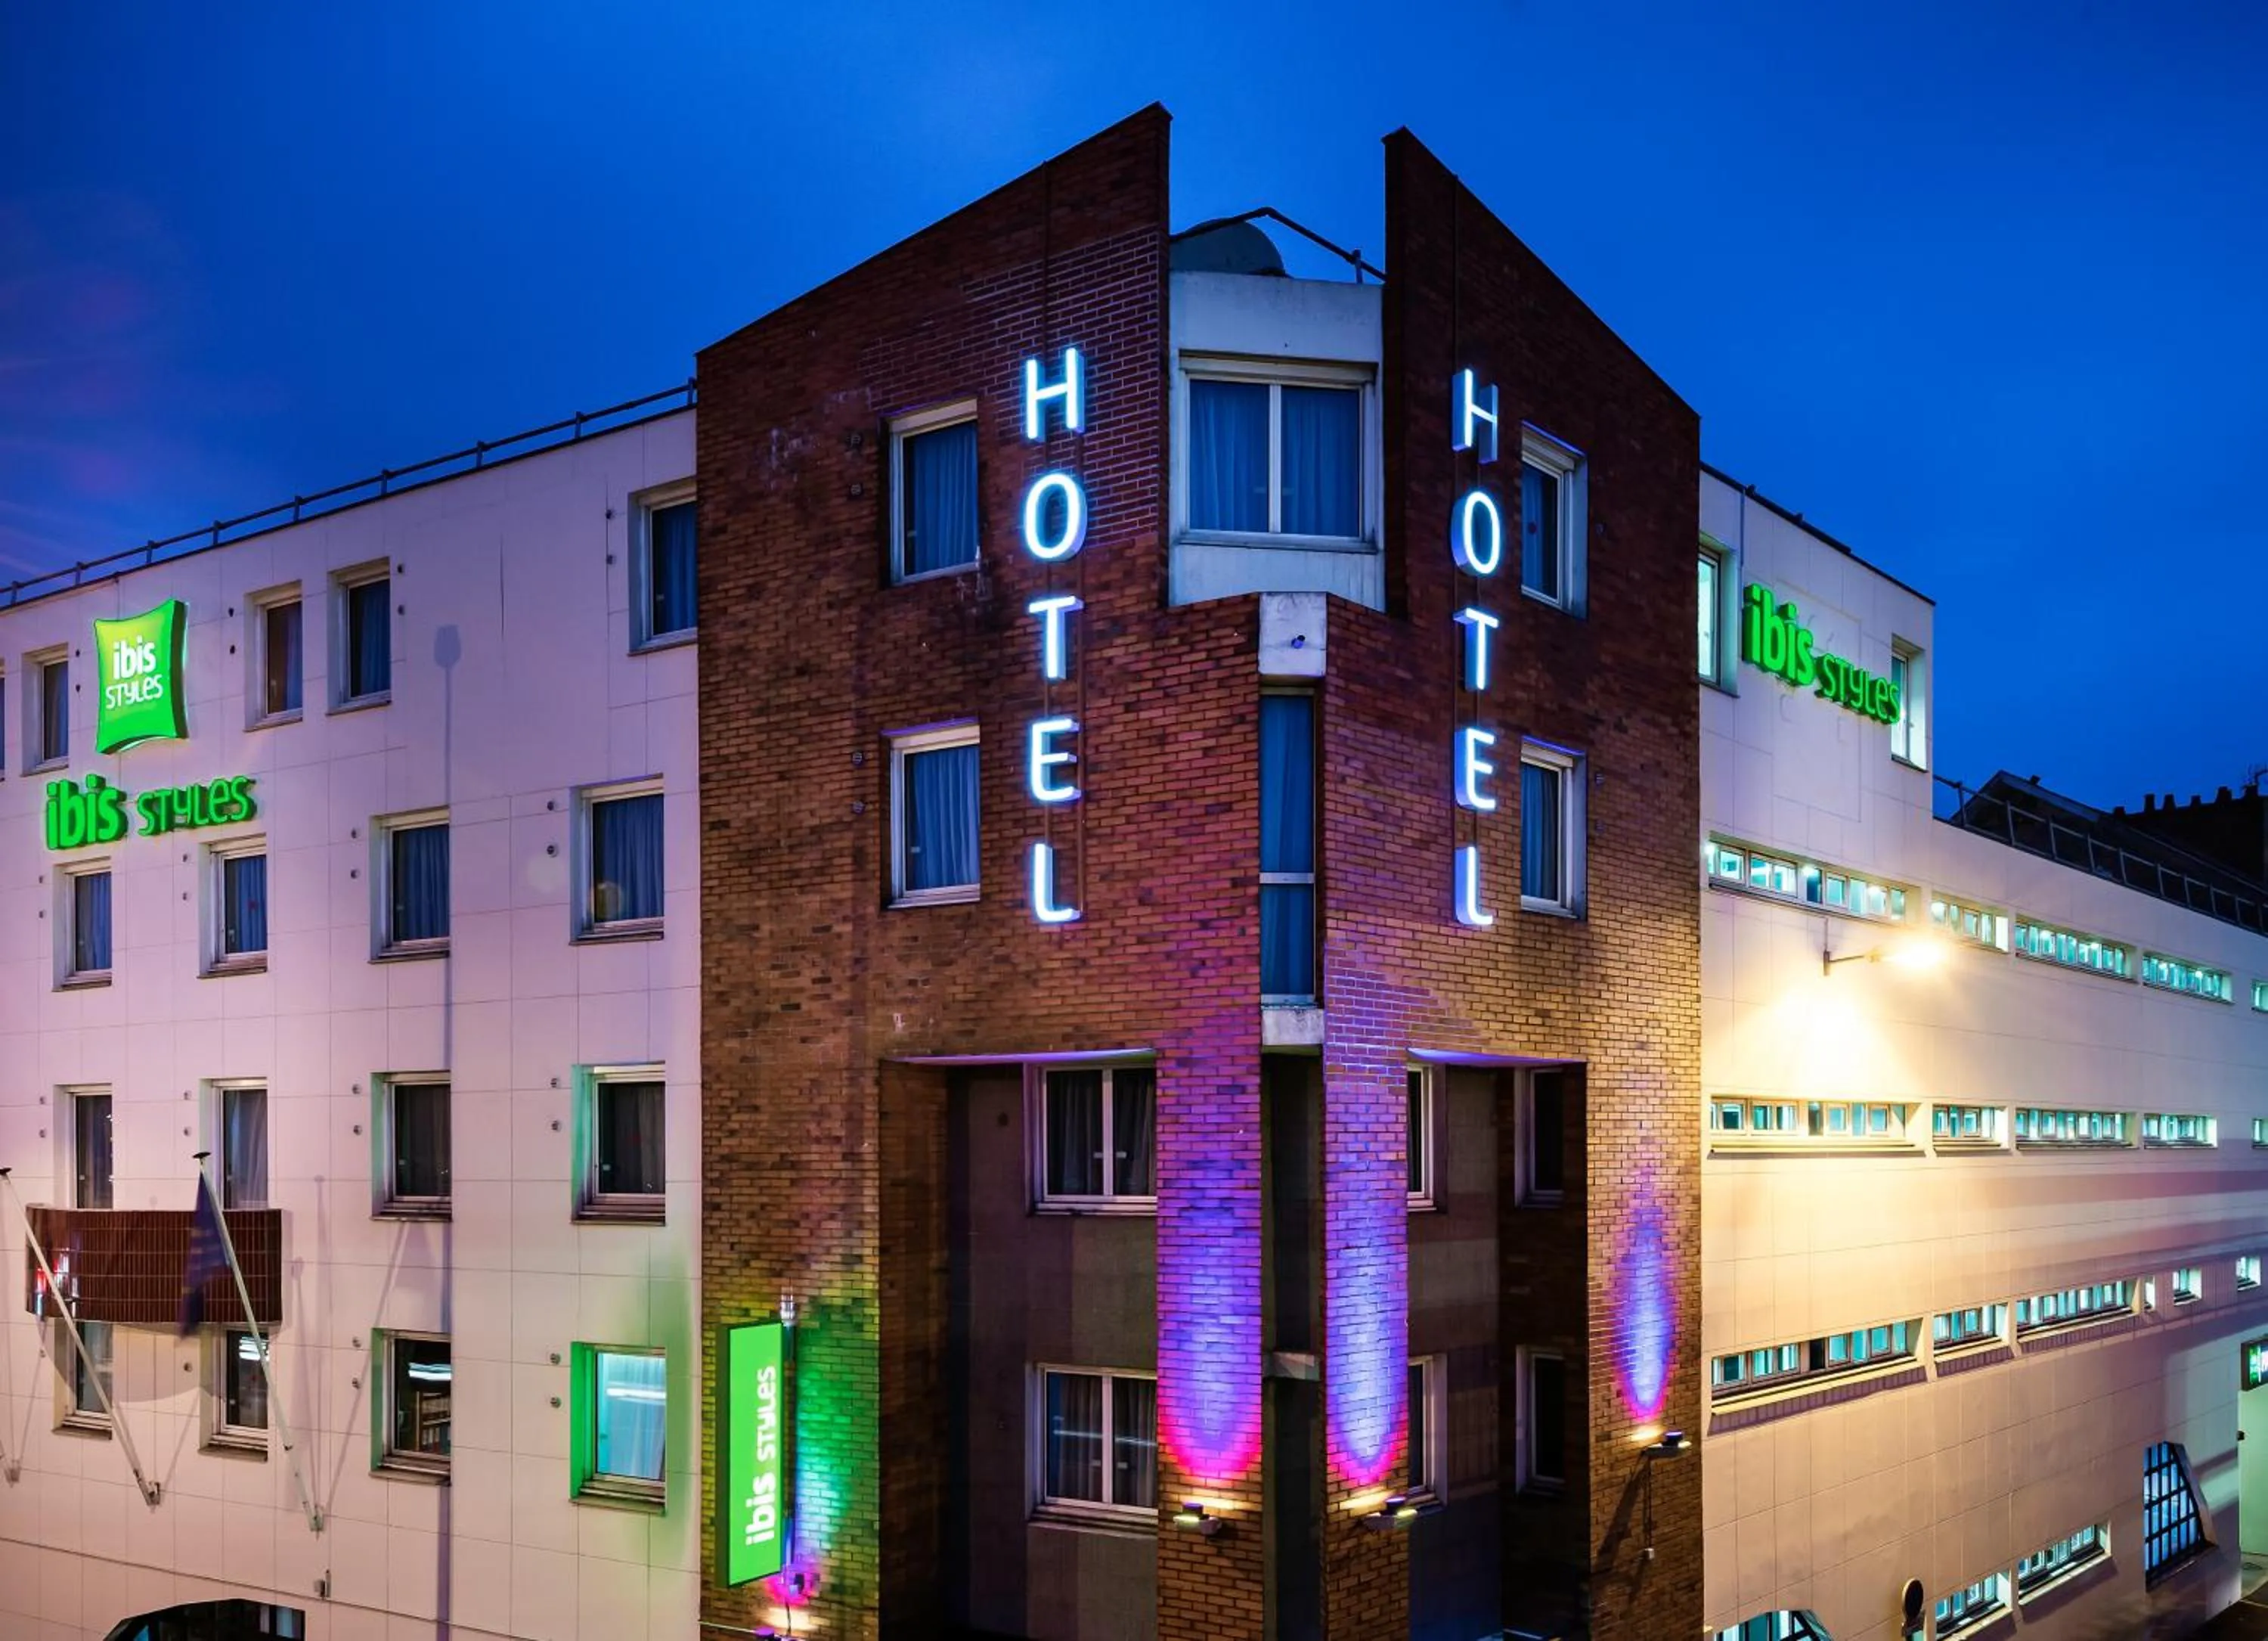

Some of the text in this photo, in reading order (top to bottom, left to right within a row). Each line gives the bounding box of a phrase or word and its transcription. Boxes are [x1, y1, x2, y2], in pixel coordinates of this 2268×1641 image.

[113, 635, 156, 679] ibis
[1025, 348, 1087, 922] HOTEL
[1452, 368, 1501, 924] HOTEL
[1743, 584, 1814, 685] ibis
[46, 774, 125, 849] ibis
[745, 1472, 776, 1546] ibis
